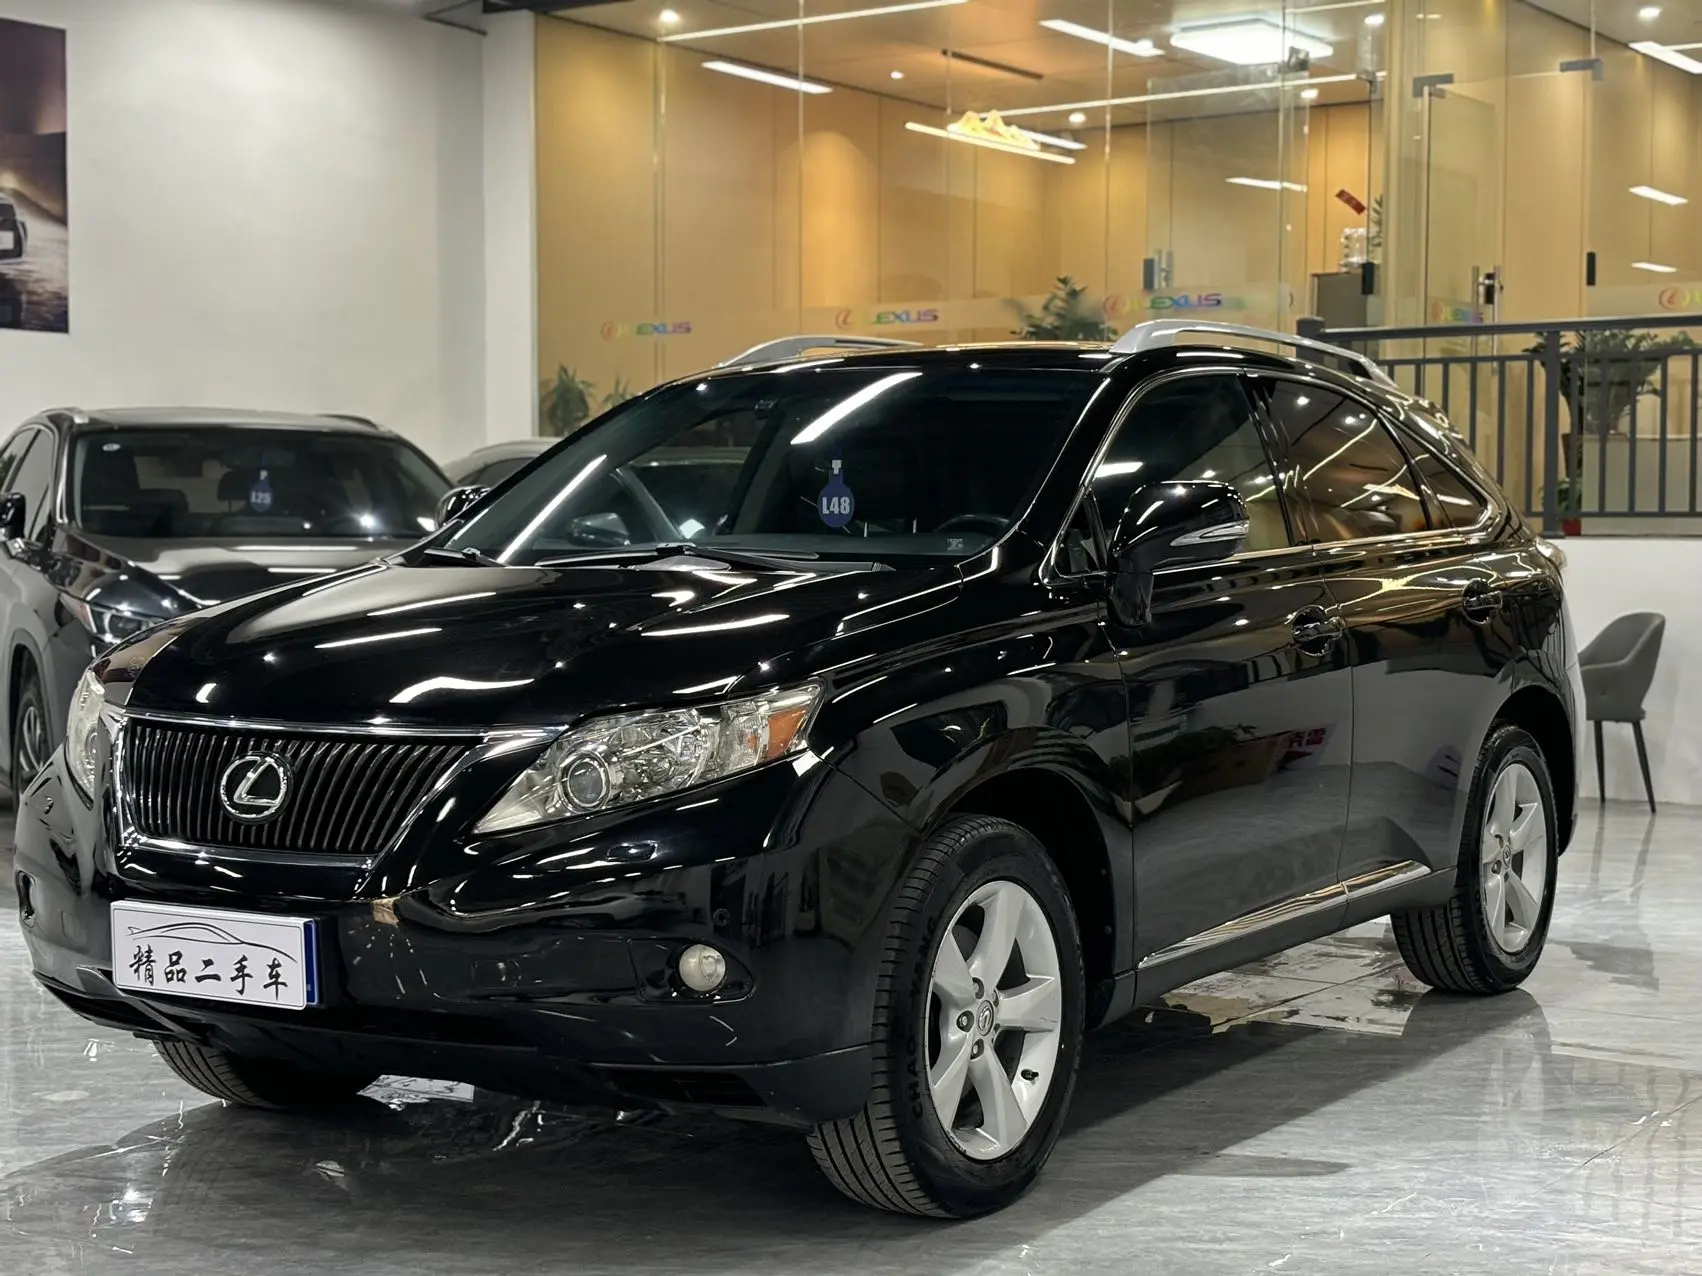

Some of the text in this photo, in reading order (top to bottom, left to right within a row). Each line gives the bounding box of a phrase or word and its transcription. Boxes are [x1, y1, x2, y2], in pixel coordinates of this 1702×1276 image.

[822, 496, 850, 515] L48
[128, 944, 288, 1000] 精品二手车
